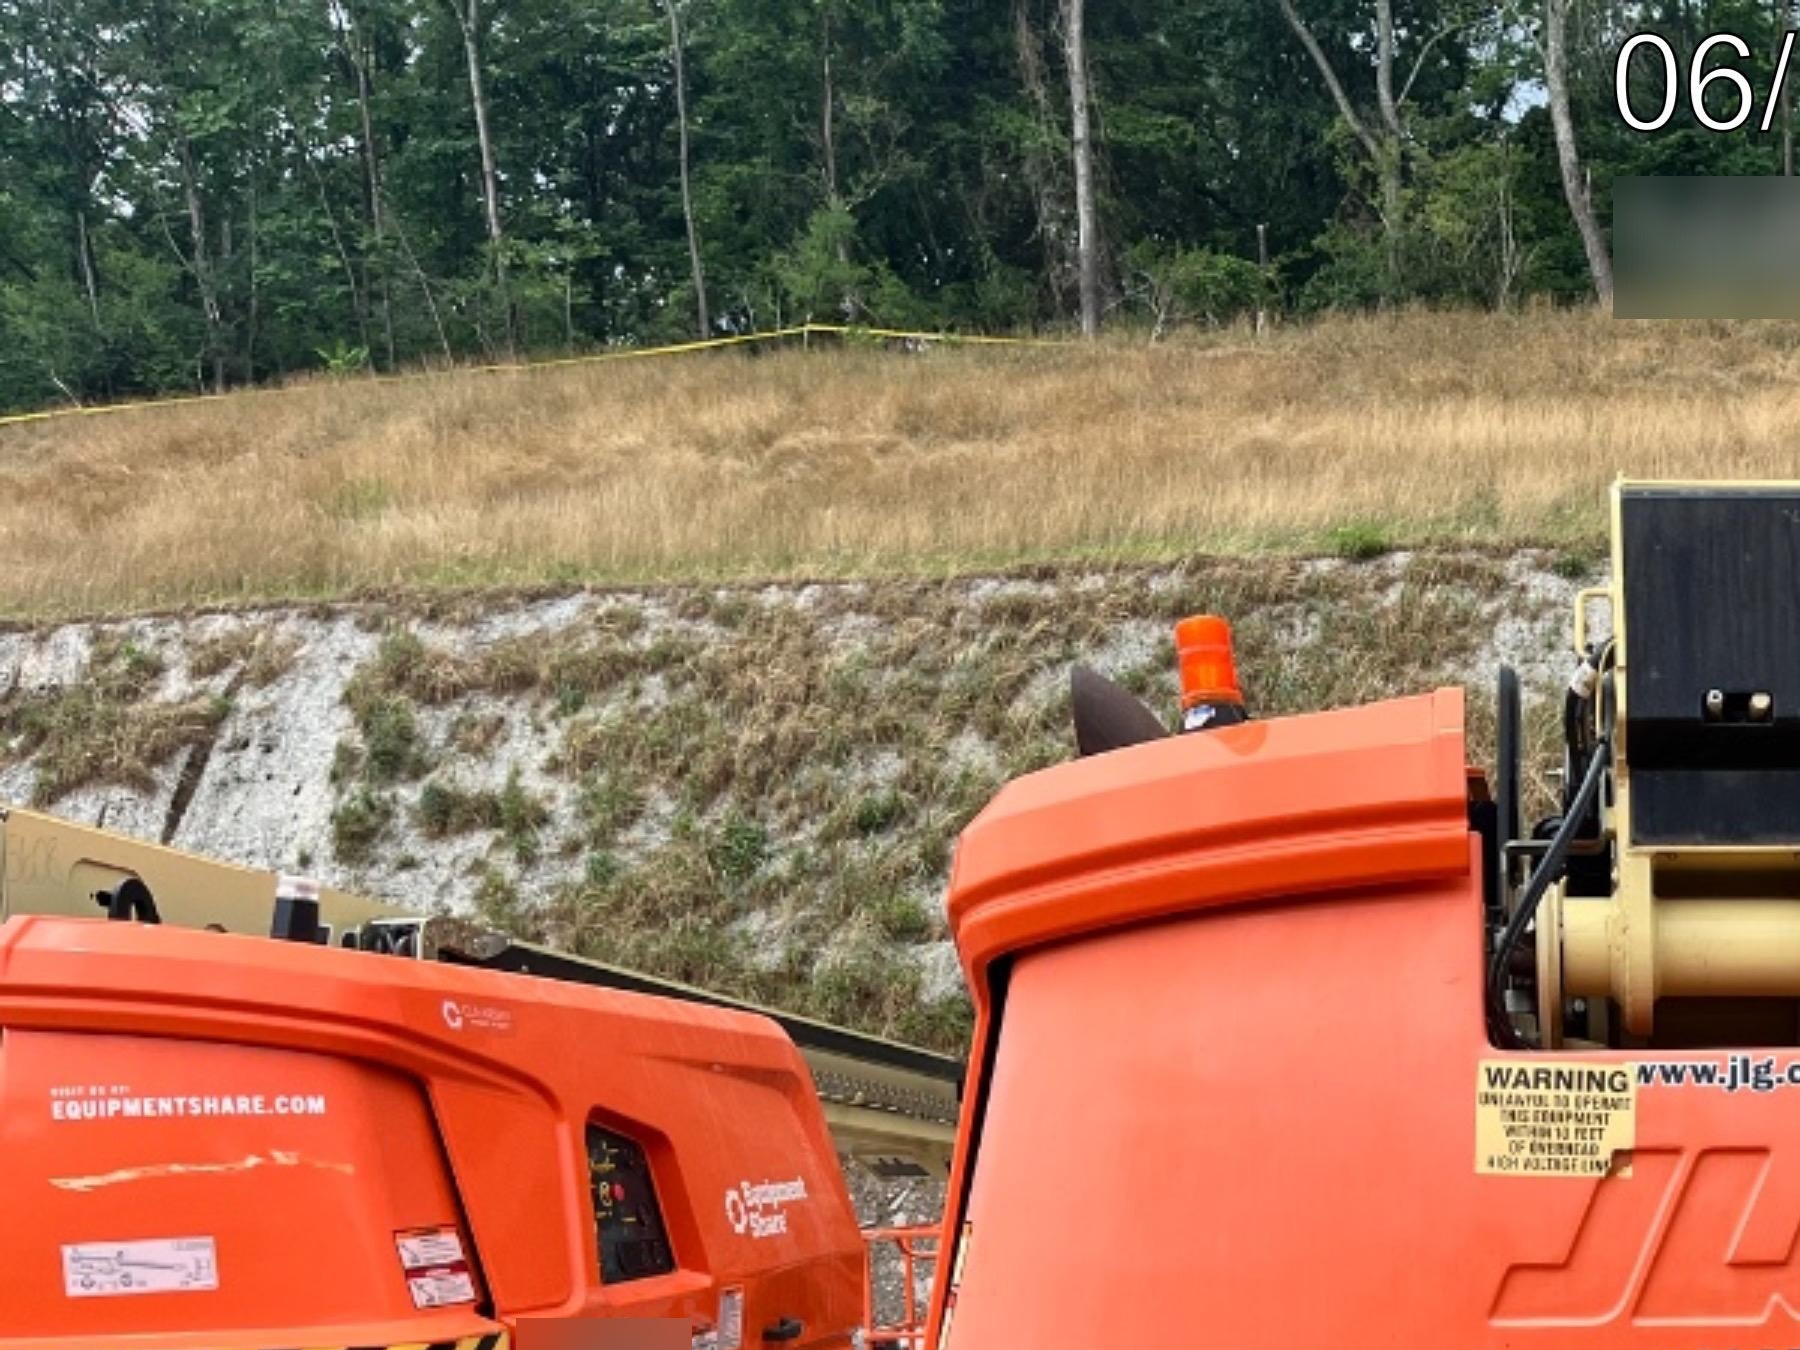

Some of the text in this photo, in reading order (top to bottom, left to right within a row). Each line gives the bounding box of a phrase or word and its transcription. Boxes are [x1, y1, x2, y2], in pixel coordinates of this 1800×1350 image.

[1484, 1066, 1629, 1093] WARNING
[51, 1094, 326, 1121] EQUIPMENTSHARE.COM
[740, 1176, 808, 1211] Equipment
[748, 1208, 787, 1238] Share
